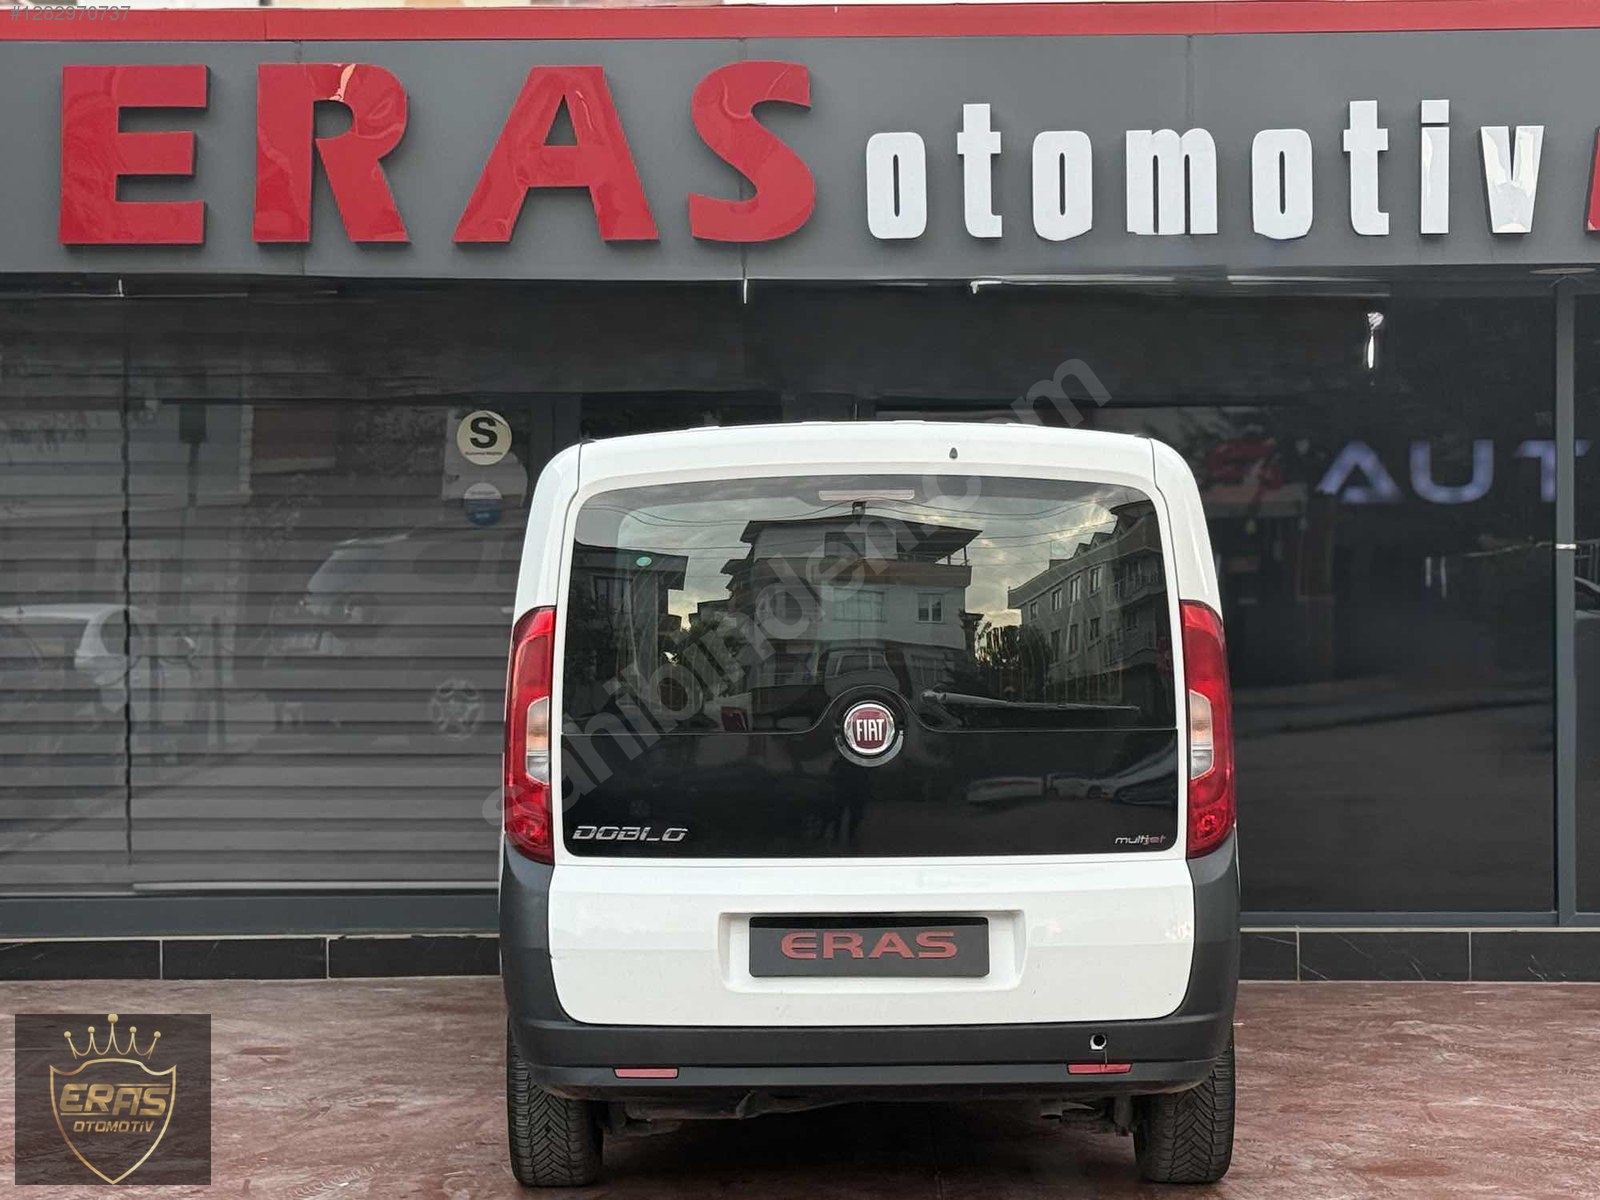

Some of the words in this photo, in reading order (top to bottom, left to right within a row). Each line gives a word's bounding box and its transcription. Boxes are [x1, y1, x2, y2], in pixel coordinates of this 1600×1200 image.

[59, 60, 816, 244] ERAS
[865, 99, 1545, 241] otomotiv
[470, 416, 498, 449] S
[856, 718, 885, 741] FIAT
[572, 825, 688, 842] DOBLO
[780, 931, 958, 960] ERAS
